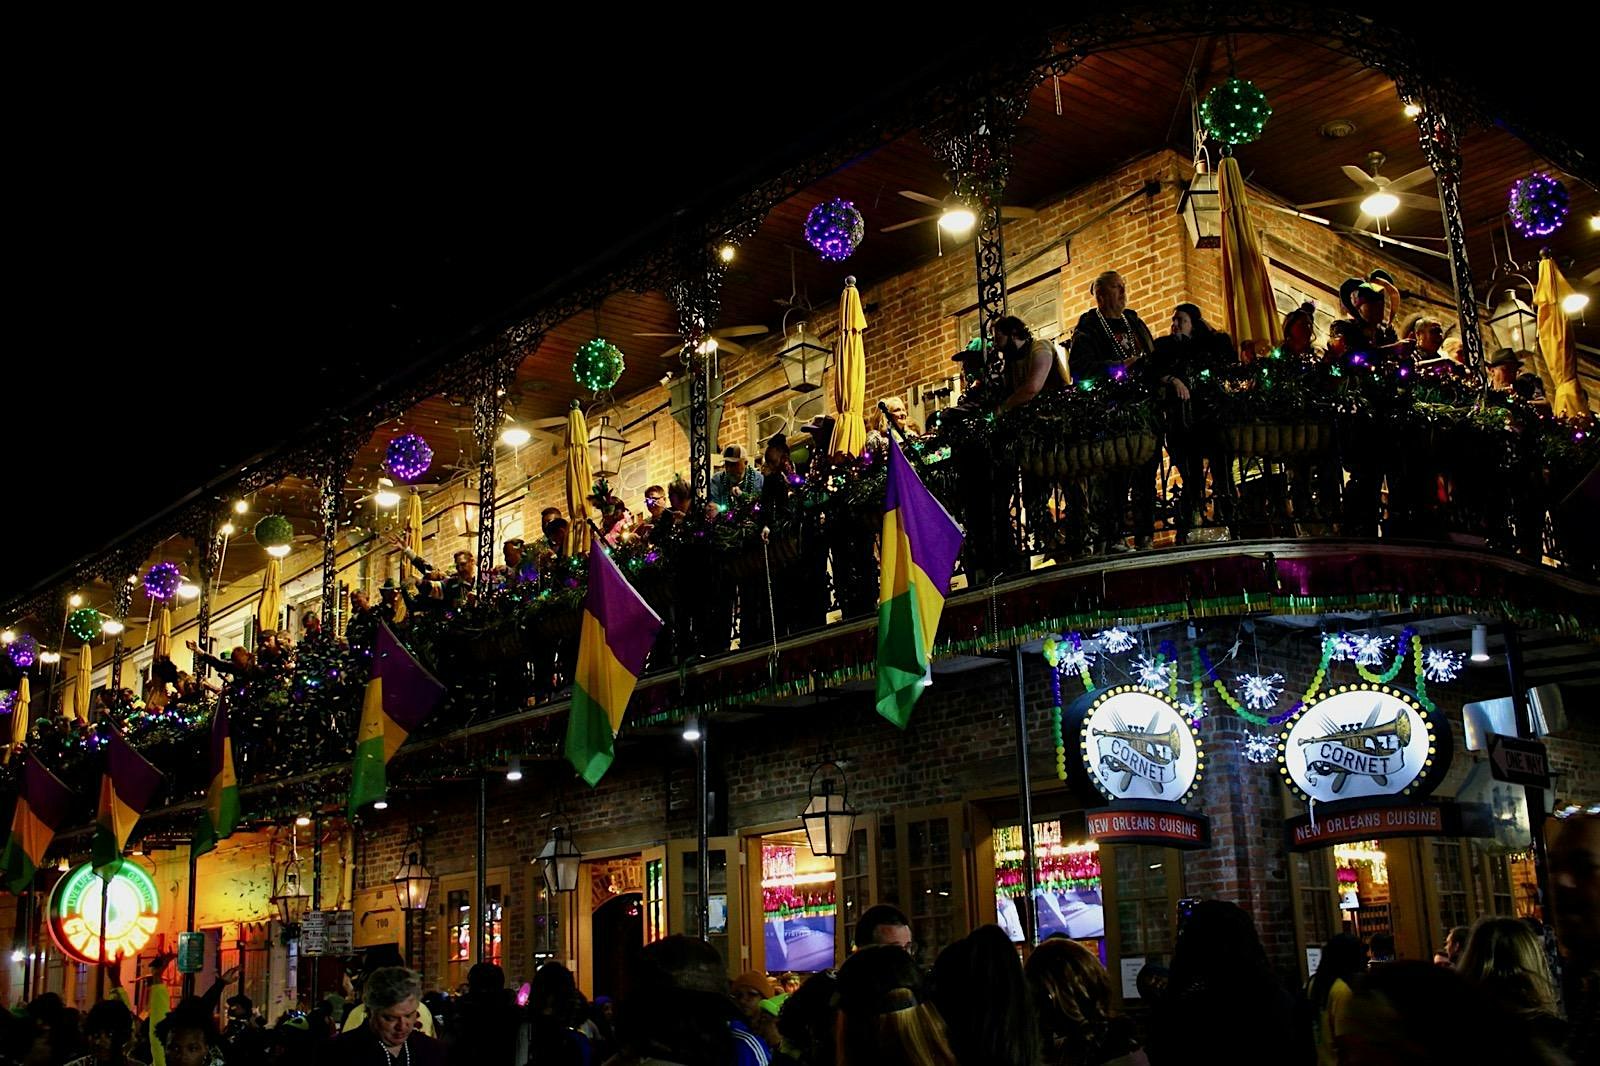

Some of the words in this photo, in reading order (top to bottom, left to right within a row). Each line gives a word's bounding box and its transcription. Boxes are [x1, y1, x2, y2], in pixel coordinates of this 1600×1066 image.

[1111, 739, 1166, 781] CORNET
[1320, 743, 1390, 774] CORNET
[1505, 750, 1525, 770] ONE
[1088, 818, 1108, 835] NEW
[1113, 816, 1156, 831] ORLEANS
[1159, 818, 1197, 837] CUISINE
[1296, 824, 1321, 840] NEW
[1327, 813, 1381, 833] ORLEANS
[1386, 811, 1437, 826] CUISINE
[68, 887, 80, 907] LIVE
[77, 873, 93, 888] LIFE
[127, 871, 152, 906] GRANDE
